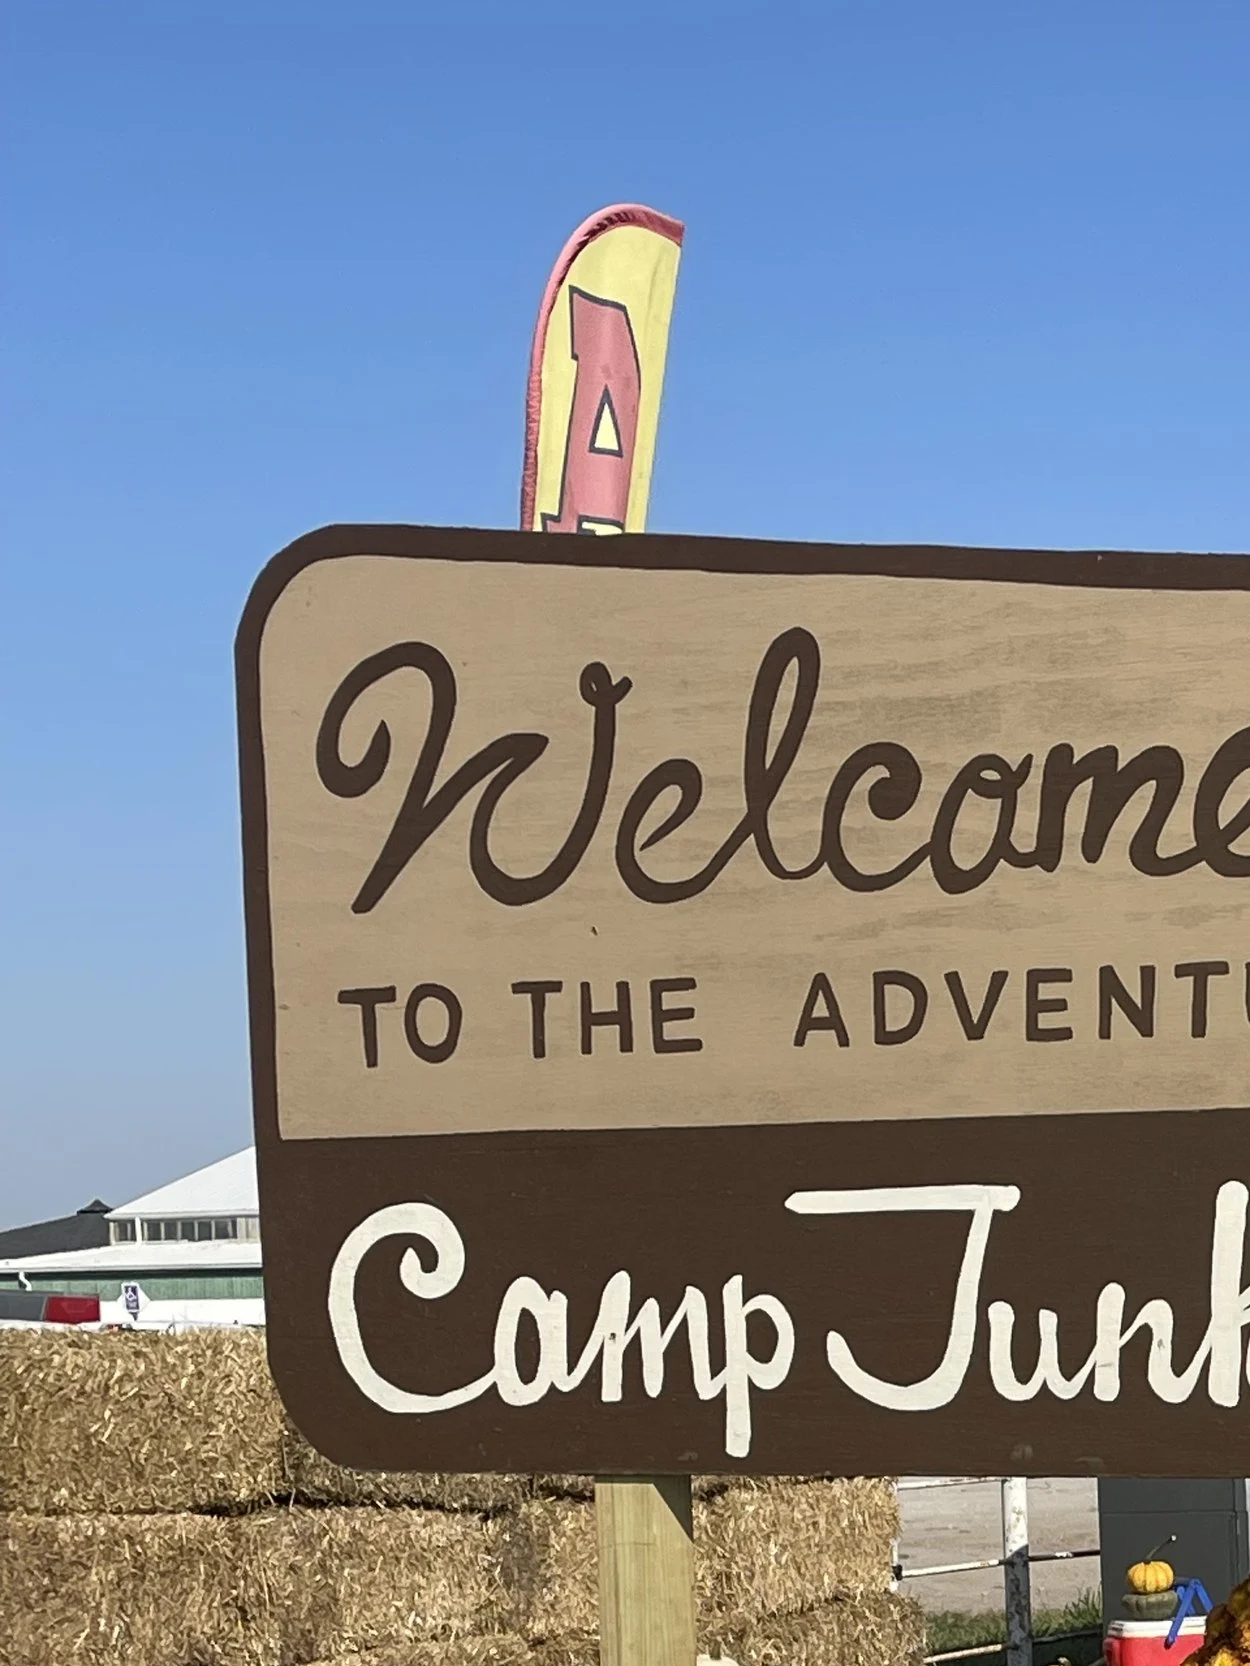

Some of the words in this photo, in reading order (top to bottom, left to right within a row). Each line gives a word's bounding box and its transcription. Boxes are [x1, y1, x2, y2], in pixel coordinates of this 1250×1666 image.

[339, 982, 462, 1067] TO
[512, 977, 702, 1058] THE
[328, 1202, 796, 1457] Camp
